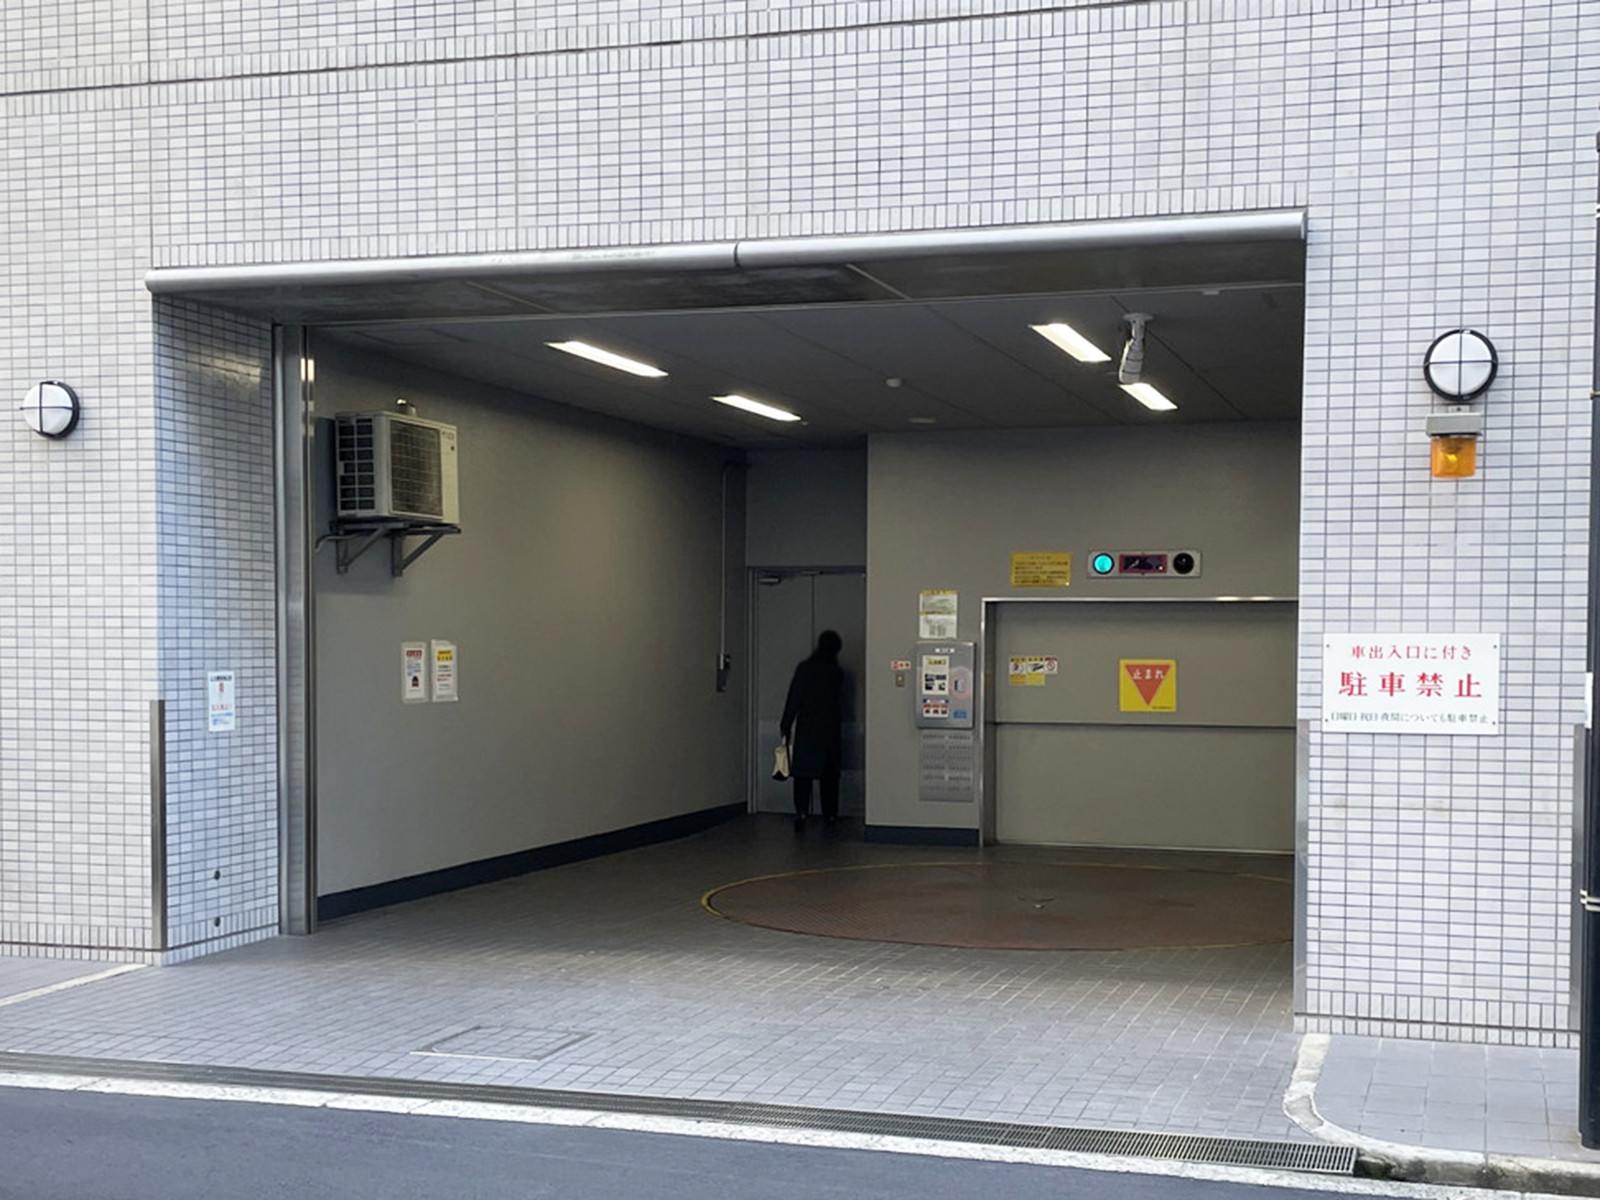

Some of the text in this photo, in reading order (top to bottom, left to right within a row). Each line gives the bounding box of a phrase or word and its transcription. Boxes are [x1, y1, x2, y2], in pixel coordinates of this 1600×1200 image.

[1352, 645, 1472, 660] 車出入口に付き
[1132, 668, 1164, 680] 止まれ
[1338, 671, 1482, 698] 駐車禁止
